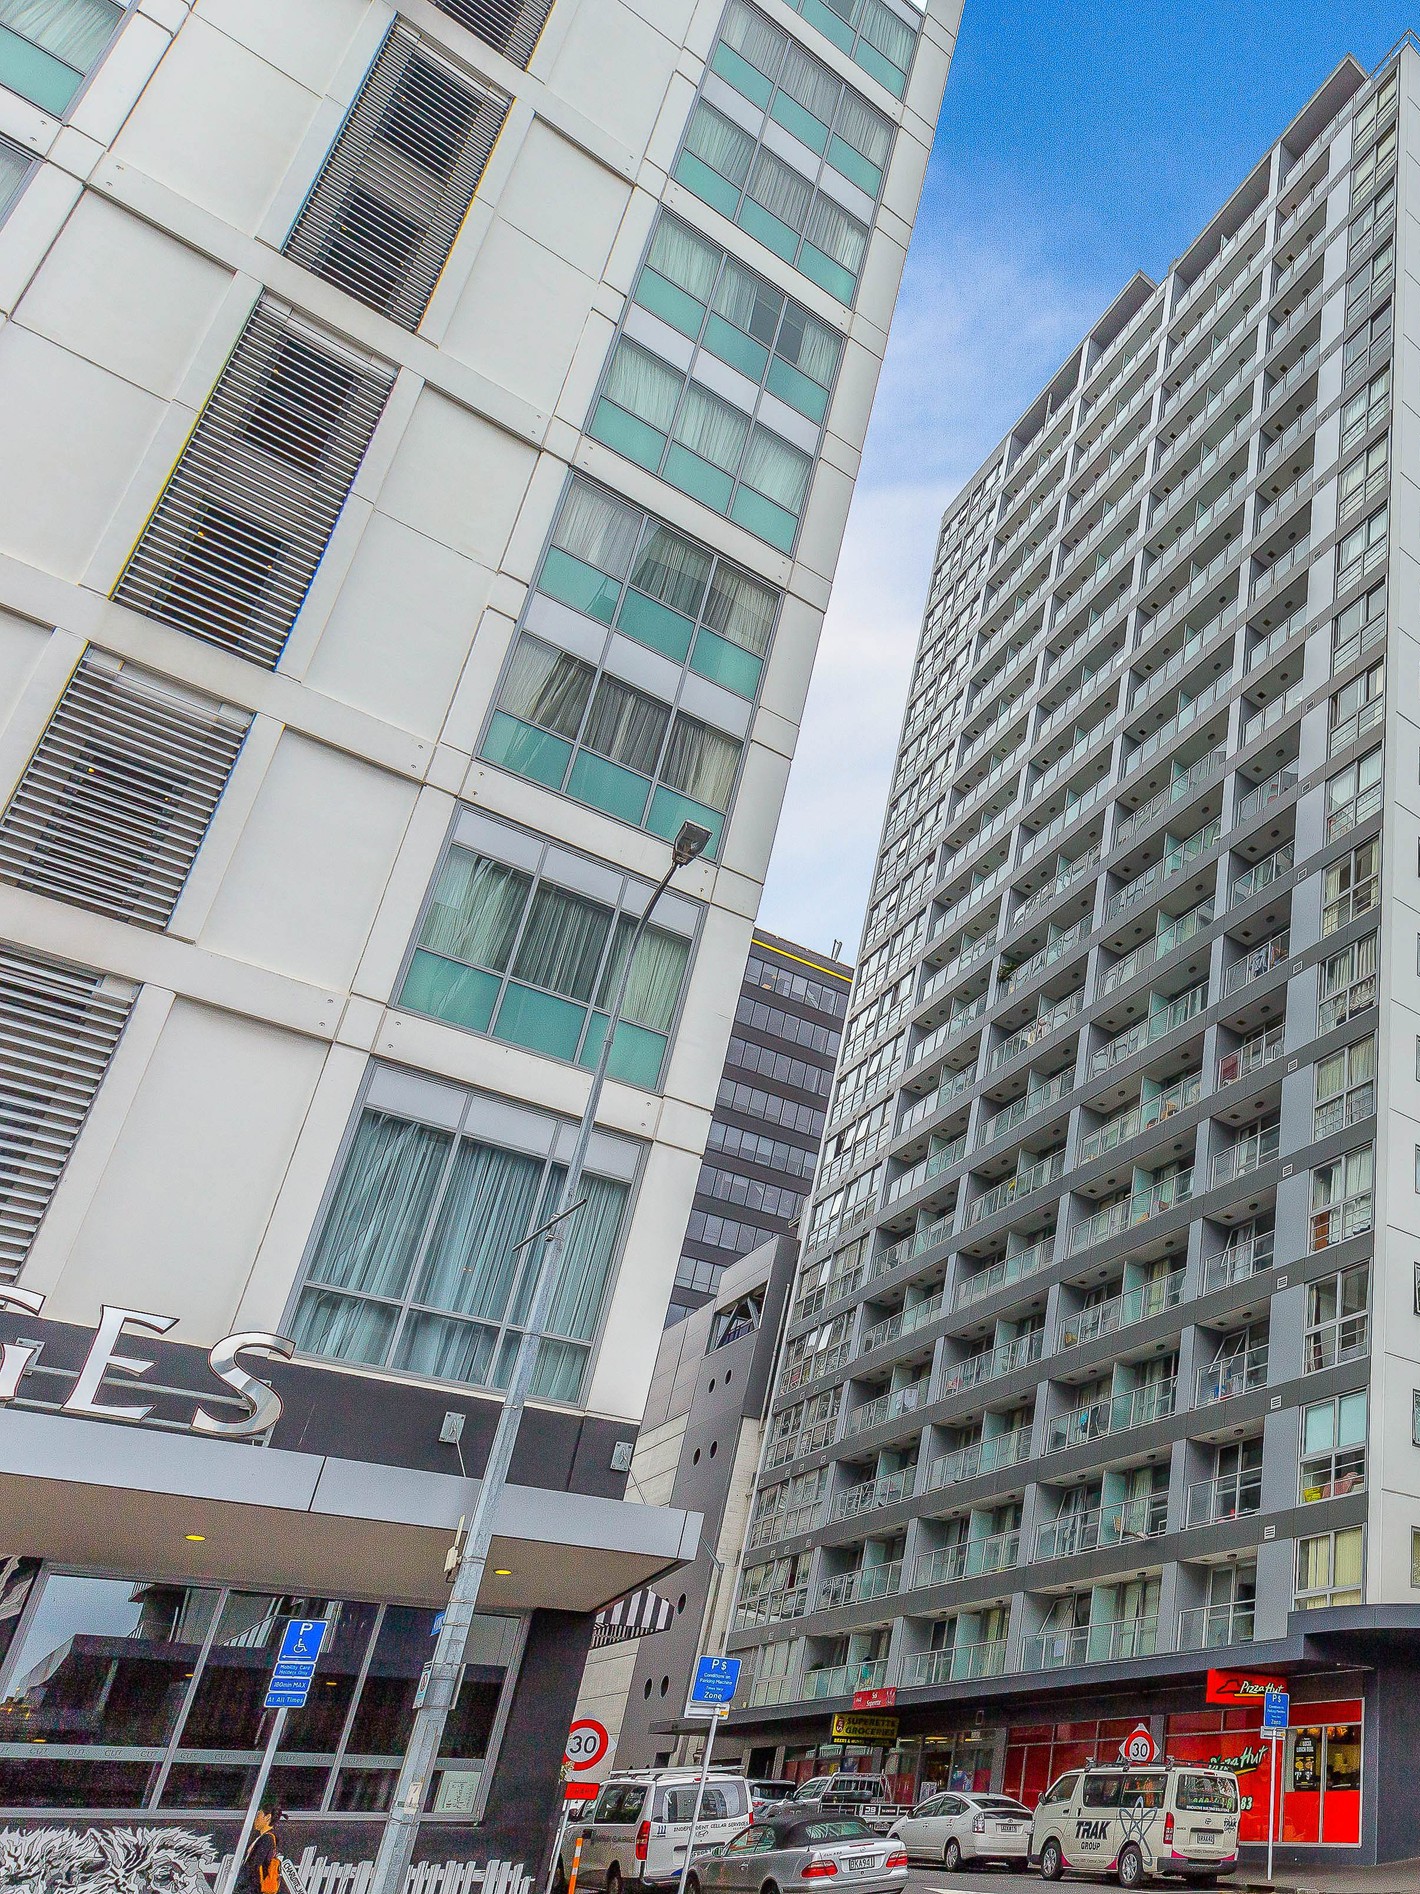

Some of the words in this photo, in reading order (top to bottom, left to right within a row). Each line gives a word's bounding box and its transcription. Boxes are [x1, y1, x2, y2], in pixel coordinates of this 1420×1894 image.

[300, 1622, 313, 1635] P
[711, 1659, 720, 1669] P
[1240, 1681, 1265, 1693] Pizza
[1265, 1683, 1284, 1694] Hut
[1272, 1694, 1277, 1702] P
[847, 1717, 896, 1726] SUPERETTE
[845, 1726, 895, 1736] GROCERIES
[570, 1735, 597, 1754] 30
[1132, 1742, 1148, 1757] 30
[1240, 1745, 1268, 1768] Hut
[1075, 1821, 1112, 1840] TRAK
[1081, 1842, 1100, 1850] GROUP
[850, 1857, 873, 1871] BKA941
